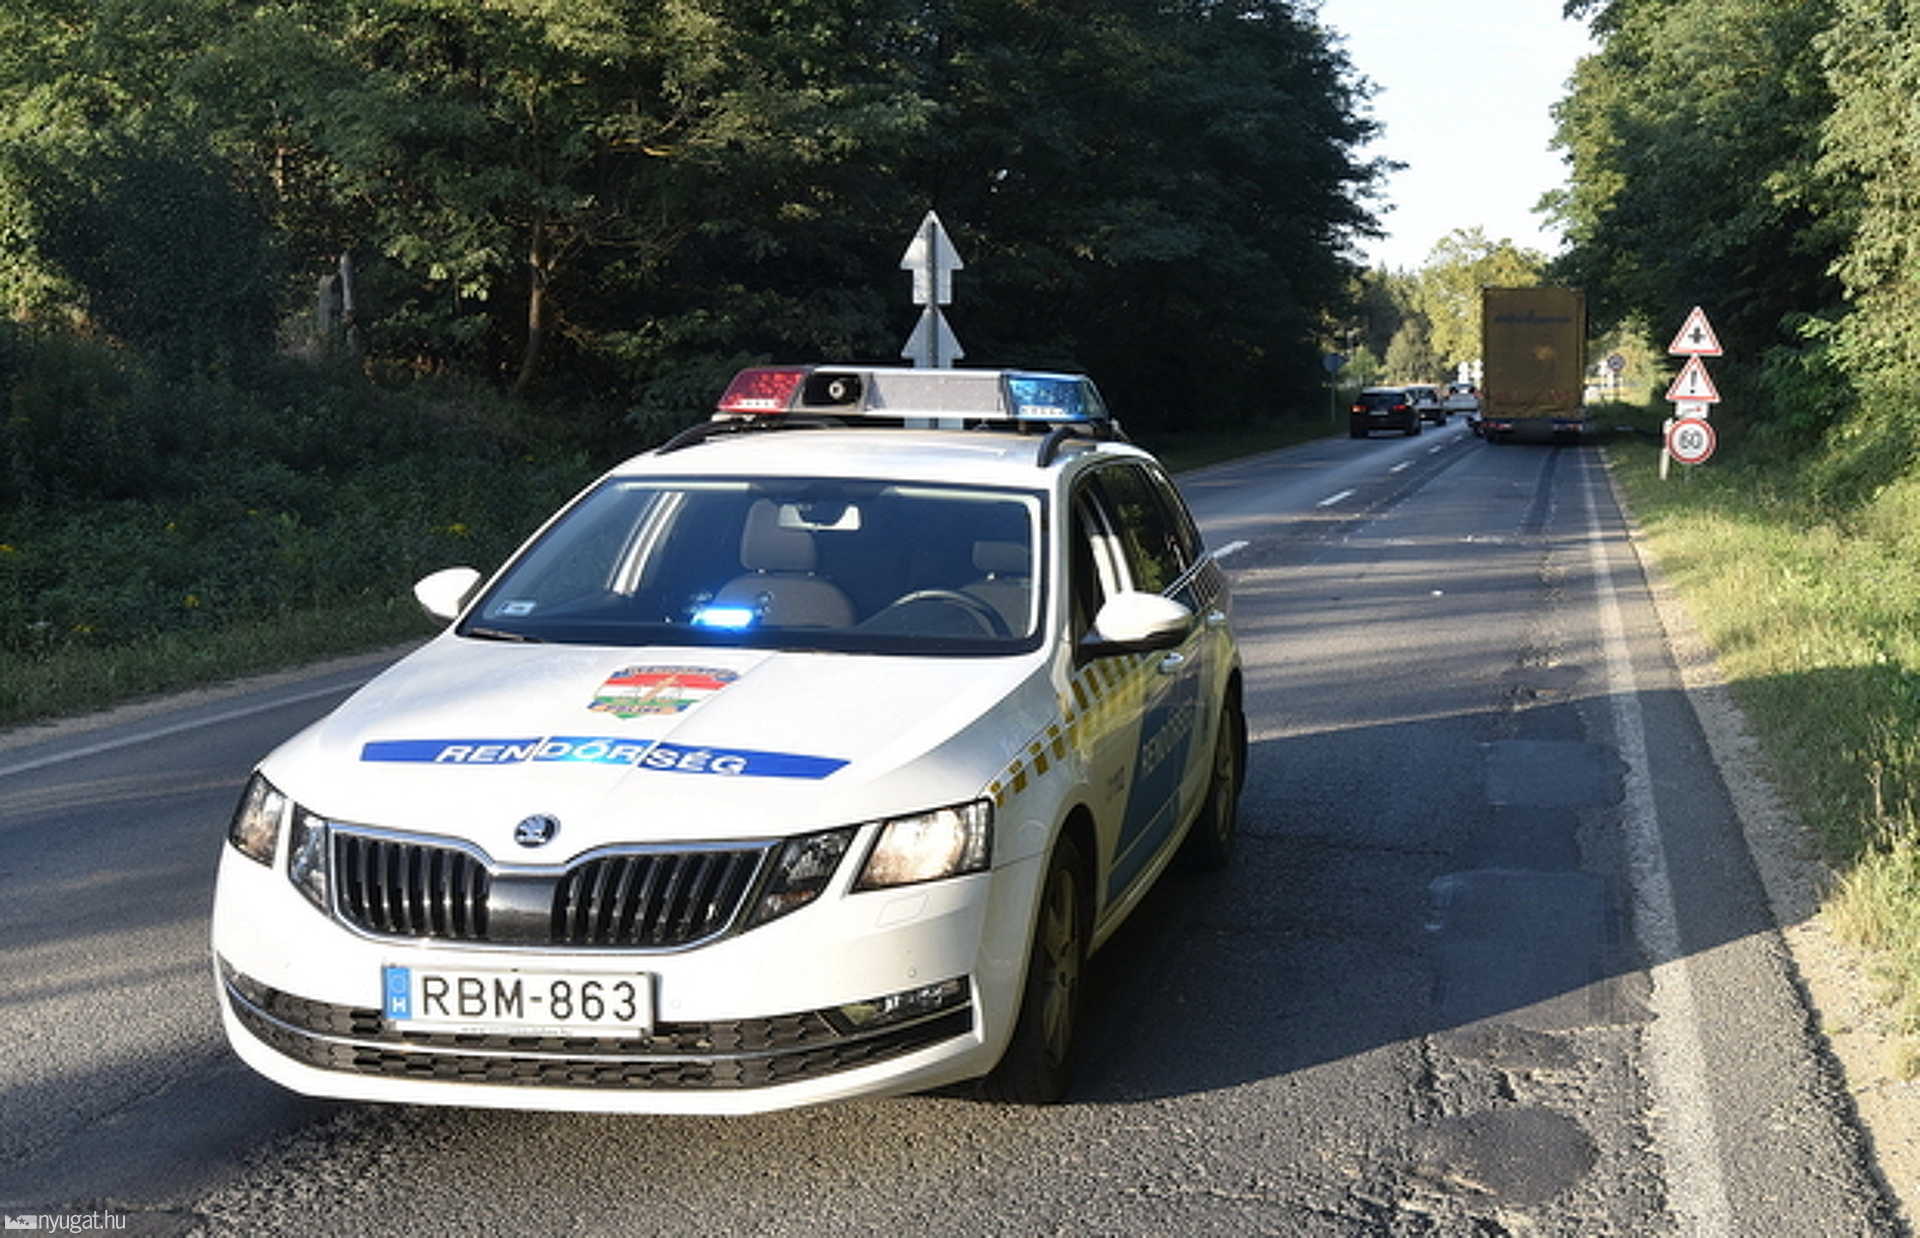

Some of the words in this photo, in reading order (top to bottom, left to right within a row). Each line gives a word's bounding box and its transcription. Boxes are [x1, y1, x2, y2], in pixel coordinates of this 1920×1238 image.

[436, 739, 747, 775] RENDŐRSÉG
[391, 998, 407, 1013] H
[422, 976, 636, 1022] RBM-863
